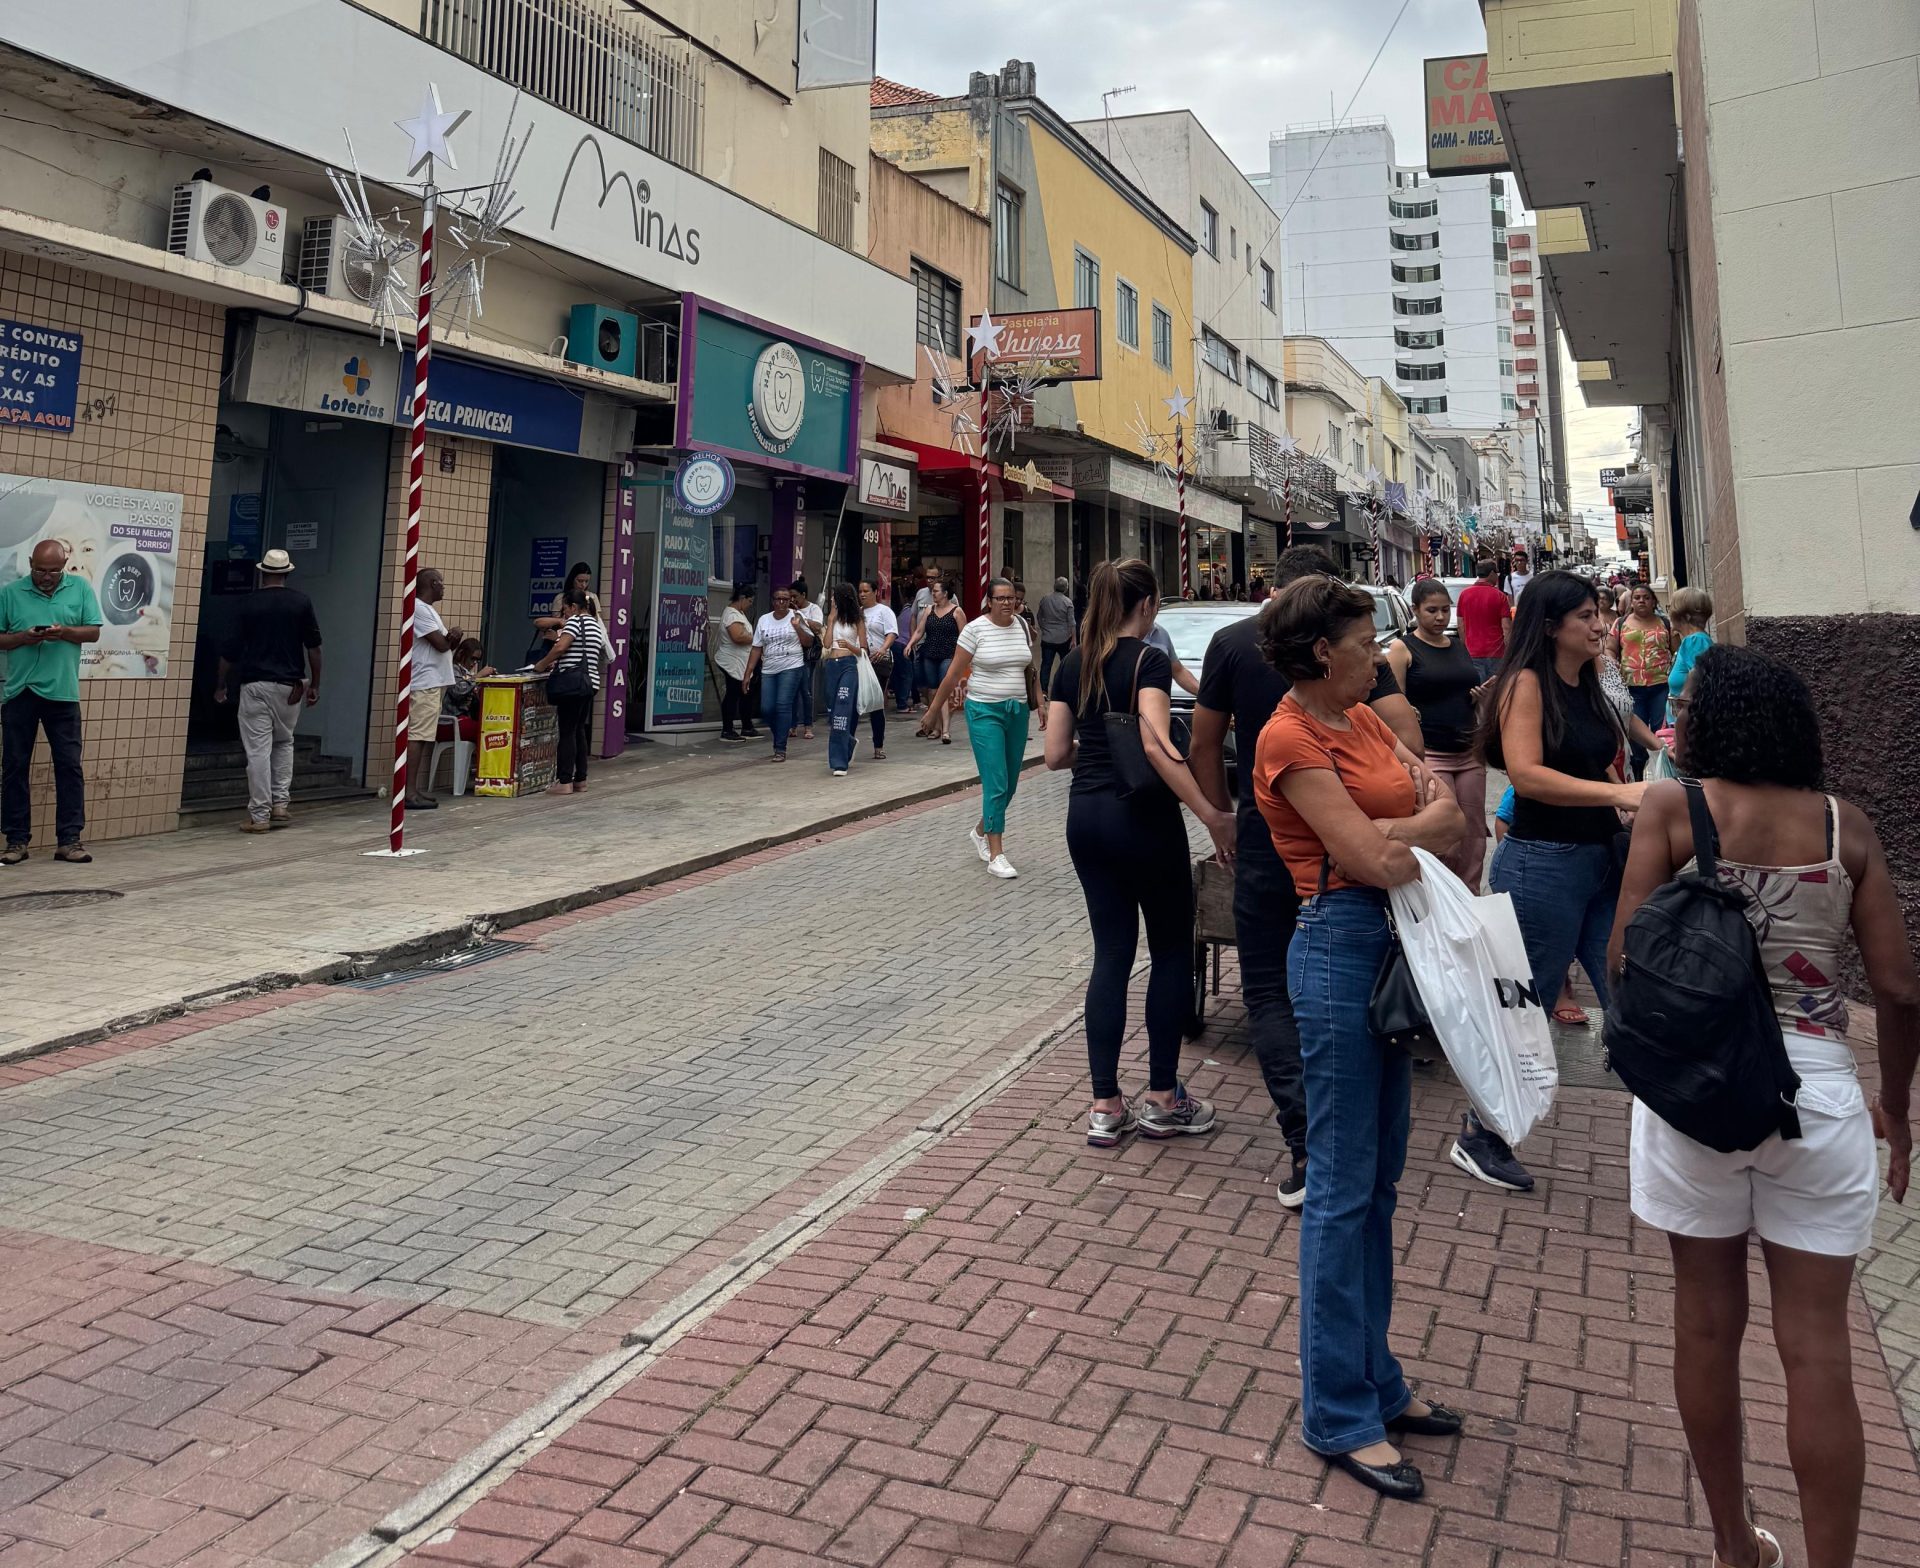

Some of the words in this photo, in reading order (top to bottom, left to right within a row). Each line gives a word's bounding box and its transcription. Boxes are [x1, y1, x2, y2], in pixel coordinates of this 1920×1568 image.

[1431, 132, 1458, 149] CAMA
[1468, 129, 1494, 147] MESA
[265, 231, 277, 243] LG
[1001, 315, 1059, 329] Pastelaria
[12, 327, 78, 352] CONTAS
[11, 368, 30, 384] C/
[34, 373, 56, 388] AS
[320, 393, 384, 419] Loterias
[34, 412, 71, 427] AQUI
[453, 406, 513, 434] PRINCESA
[692, 453, 720, 463] MELHOR
[153, 500, 163, 512] A
[164, 502, 175, 514] 10
[685, 503, 692, 511] DE
[694, 502, 722, 514] VARGINHA
[129, 513, 174, 527] PASSOS
[113, 526, 125, 535] DO
[126, 528, 141, 537] SEU
[142, 529, 173, 540] MELHOR
[863, 529, 879, 543] 499
[664, 535, 682, 550] RAIO
[683, 538, 690, 551] X
[532, 581, 563, 591] CAIXA
